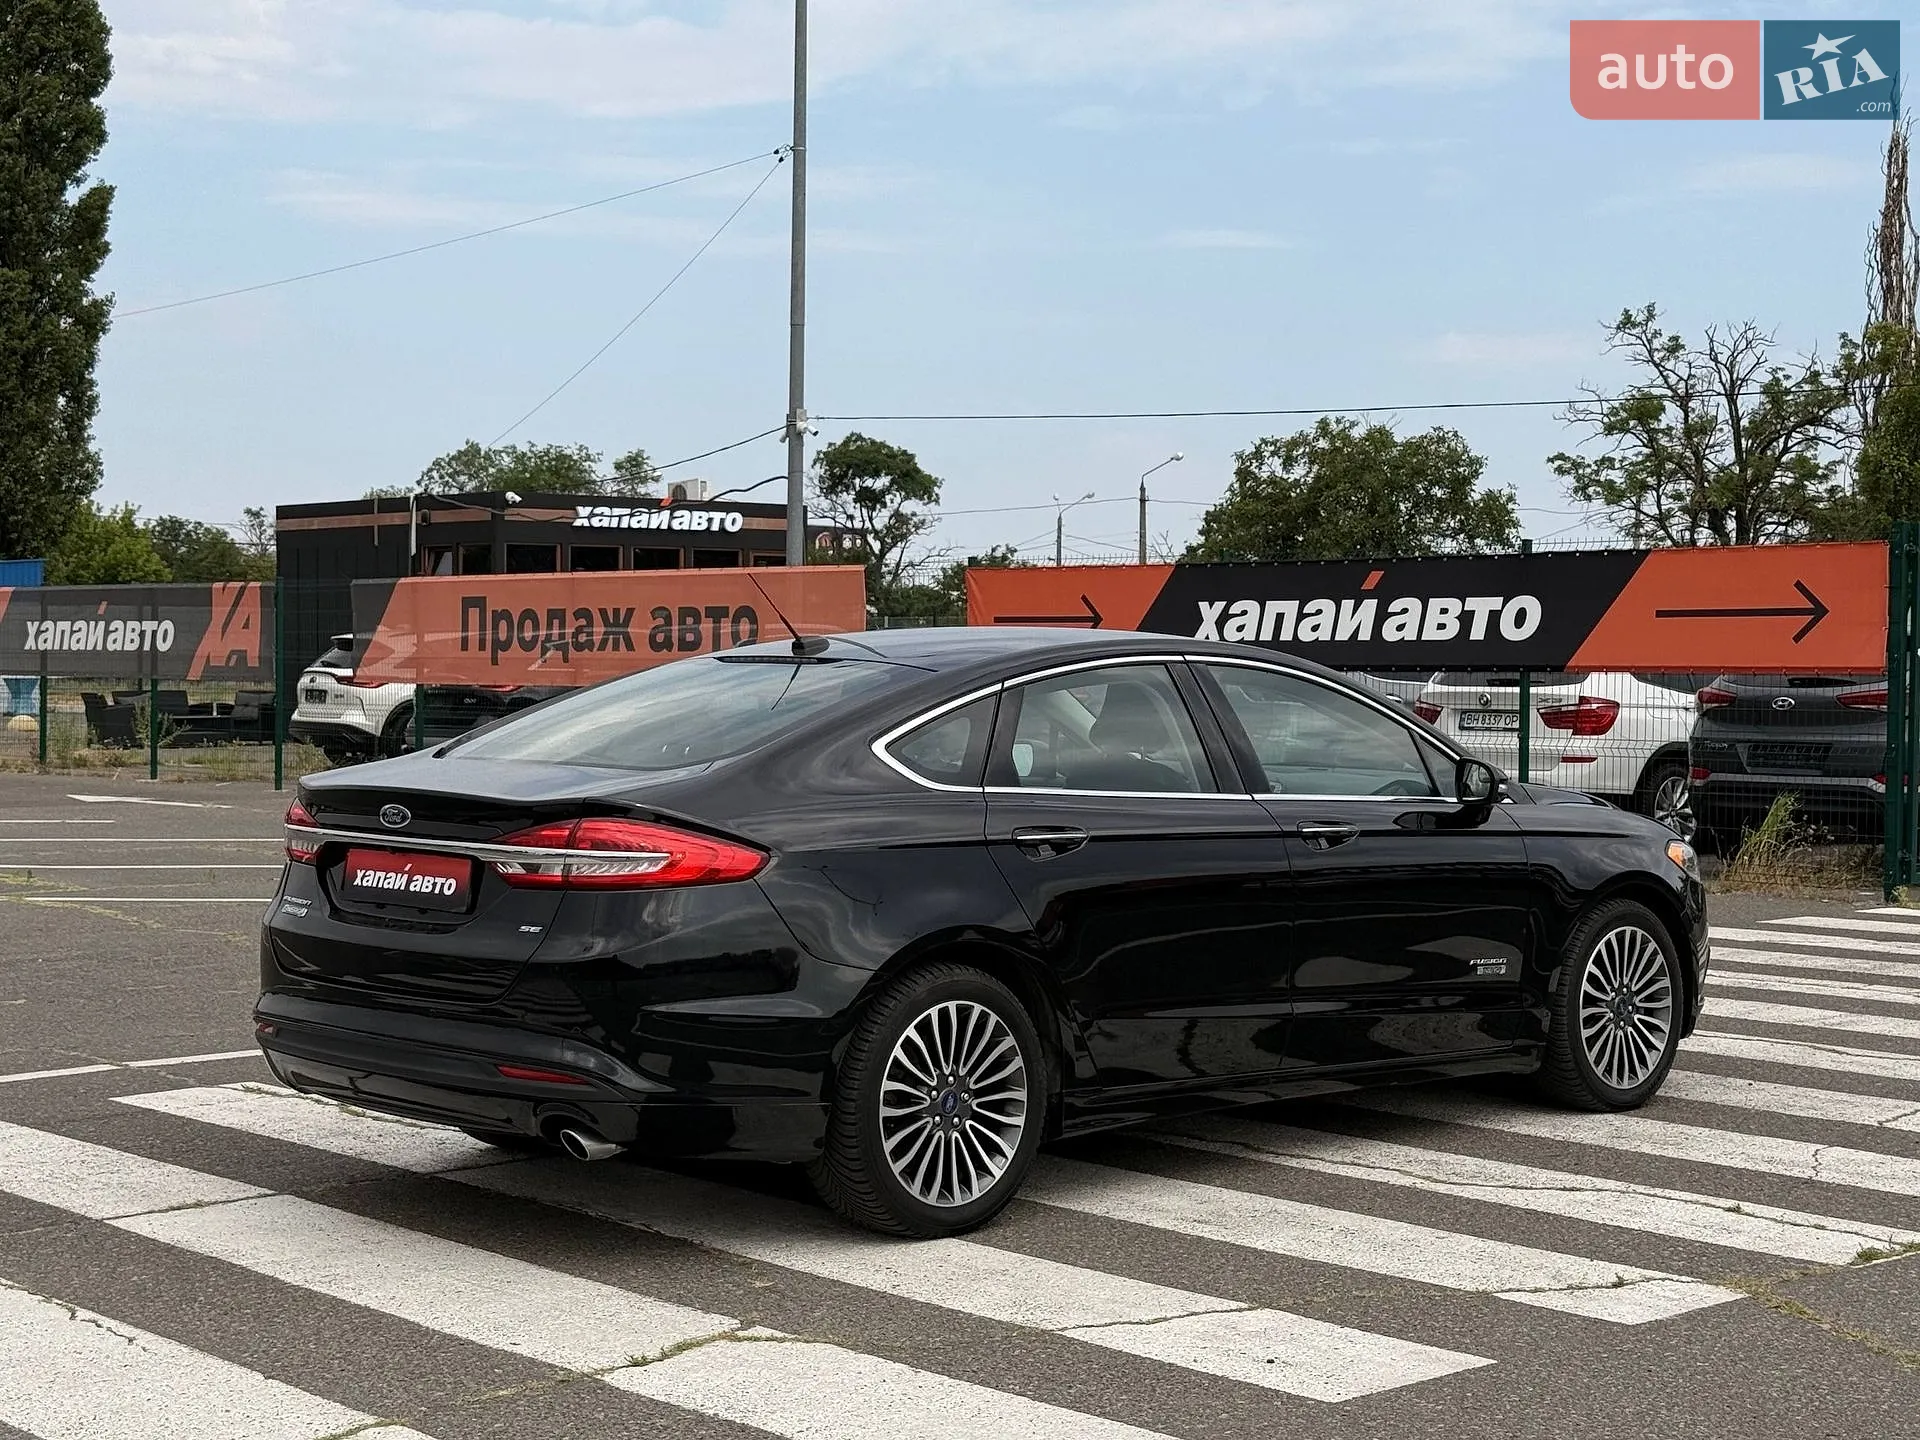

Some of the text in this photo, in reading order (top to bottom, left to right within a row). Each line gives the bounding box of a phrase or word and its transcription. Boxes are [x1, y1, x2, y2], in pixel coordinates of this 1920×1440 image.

[670, 509, 744, 533] авто
[24, 601, 175, 652] хапай авто
[460, 595, 759, 666] Продаж авто
[1194, 571, 1542, 642] хапай авто
[353, 863, 457, 896] хапай авто
